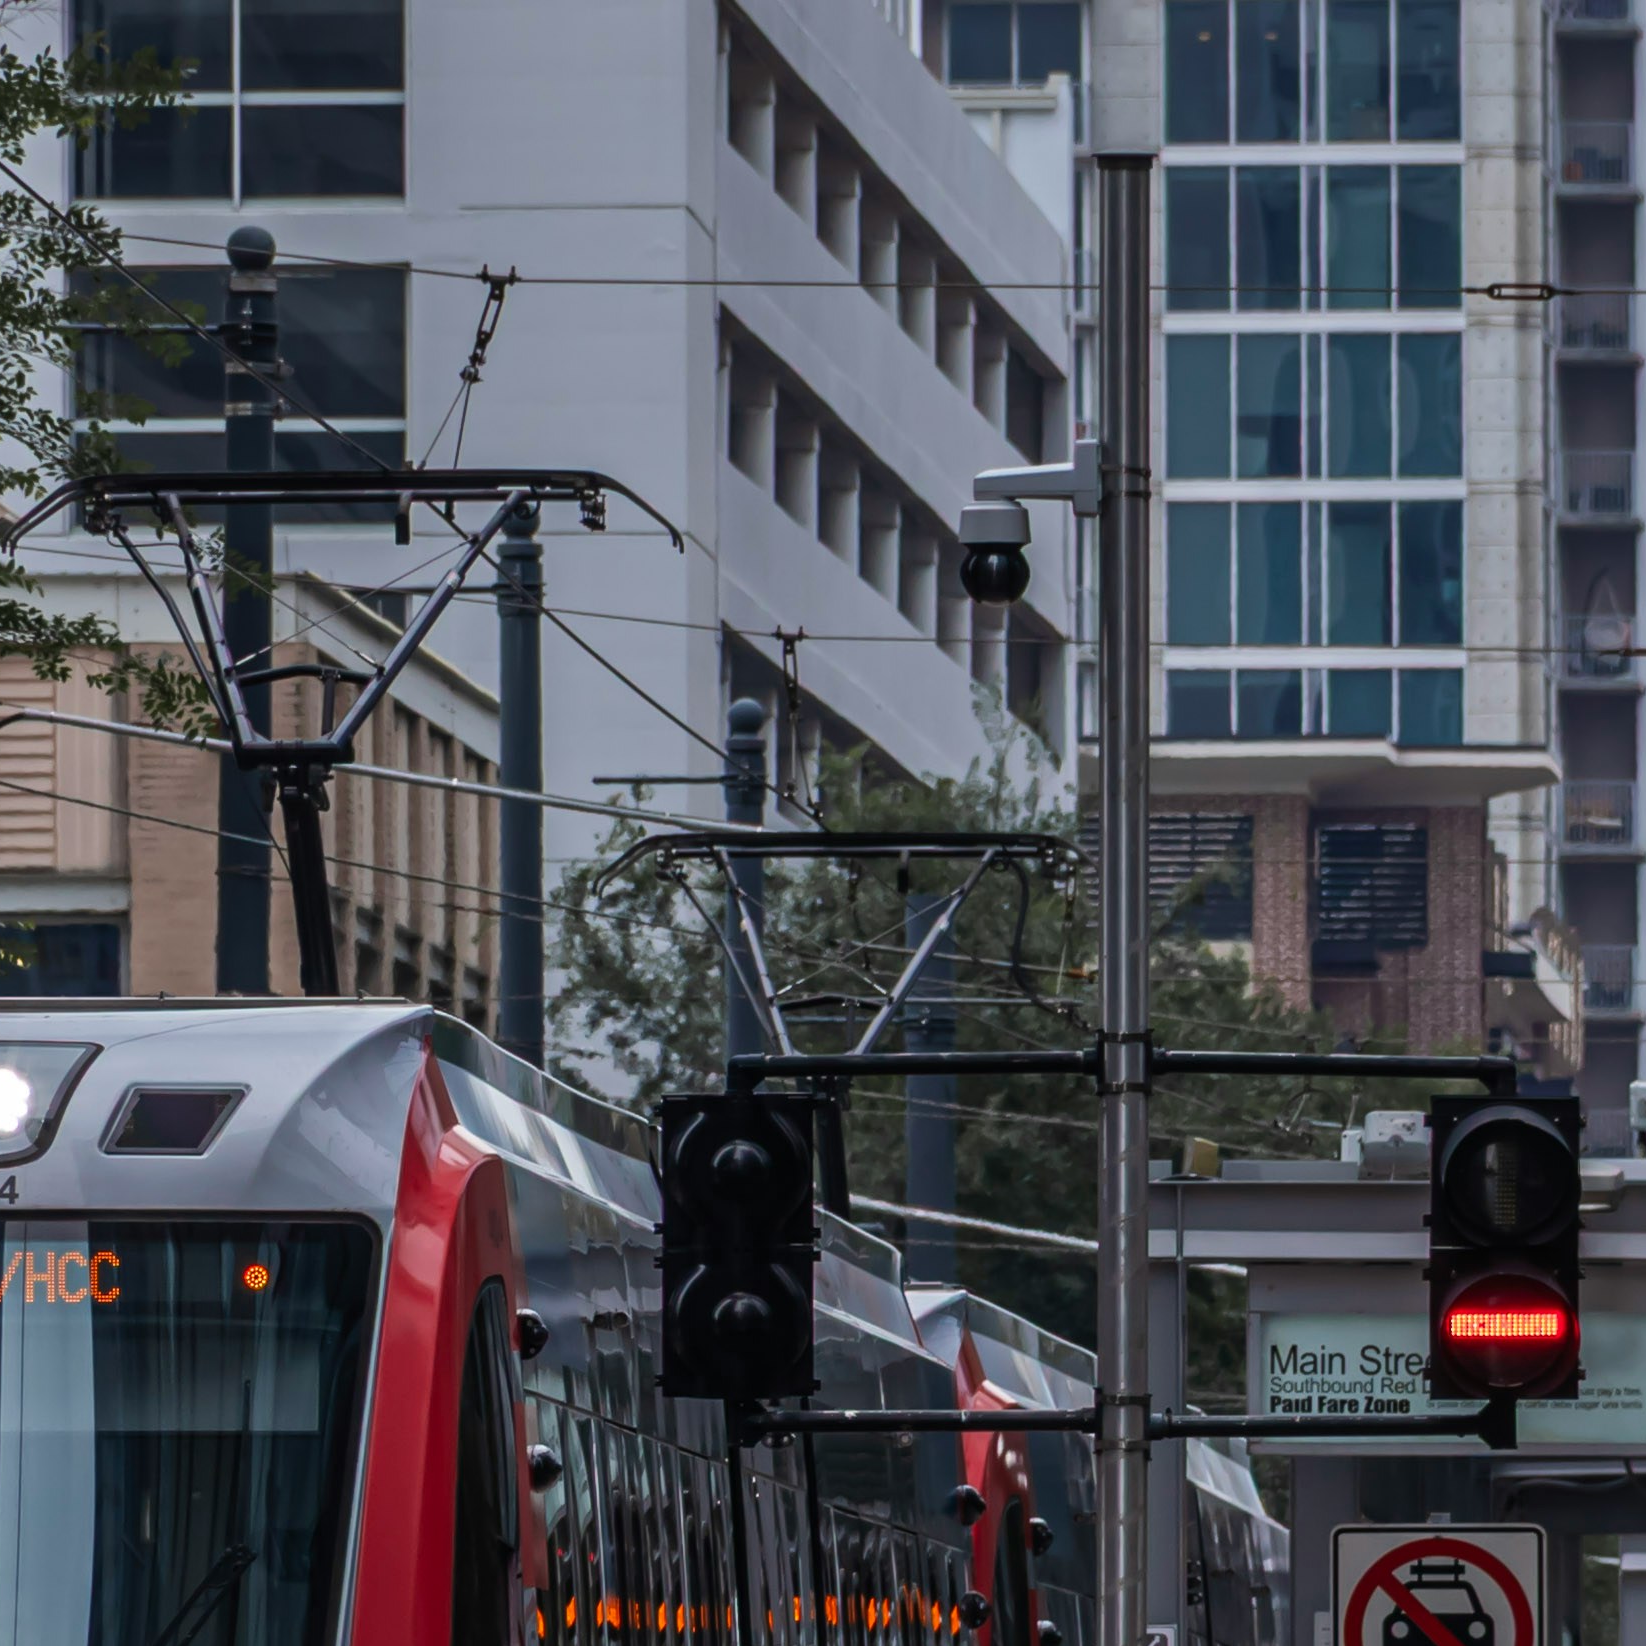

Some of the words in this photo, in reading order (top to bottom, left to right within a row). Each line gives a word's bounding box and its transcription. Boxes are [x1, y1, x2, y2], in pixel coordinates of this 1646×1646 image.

[1269, 1344, 1346, 1376] Main
[1359, 1344, 1431, 1376] Stre
[1270, 1376, 1374, 1394] Southbound
[1380, 1376, 1416, 1394] Red
[1270, 1395, 1312, 1413] Paid
[1317, 1395, 1360, 1413] Fare
[1364, 1395, 1411, 1413] Zone
